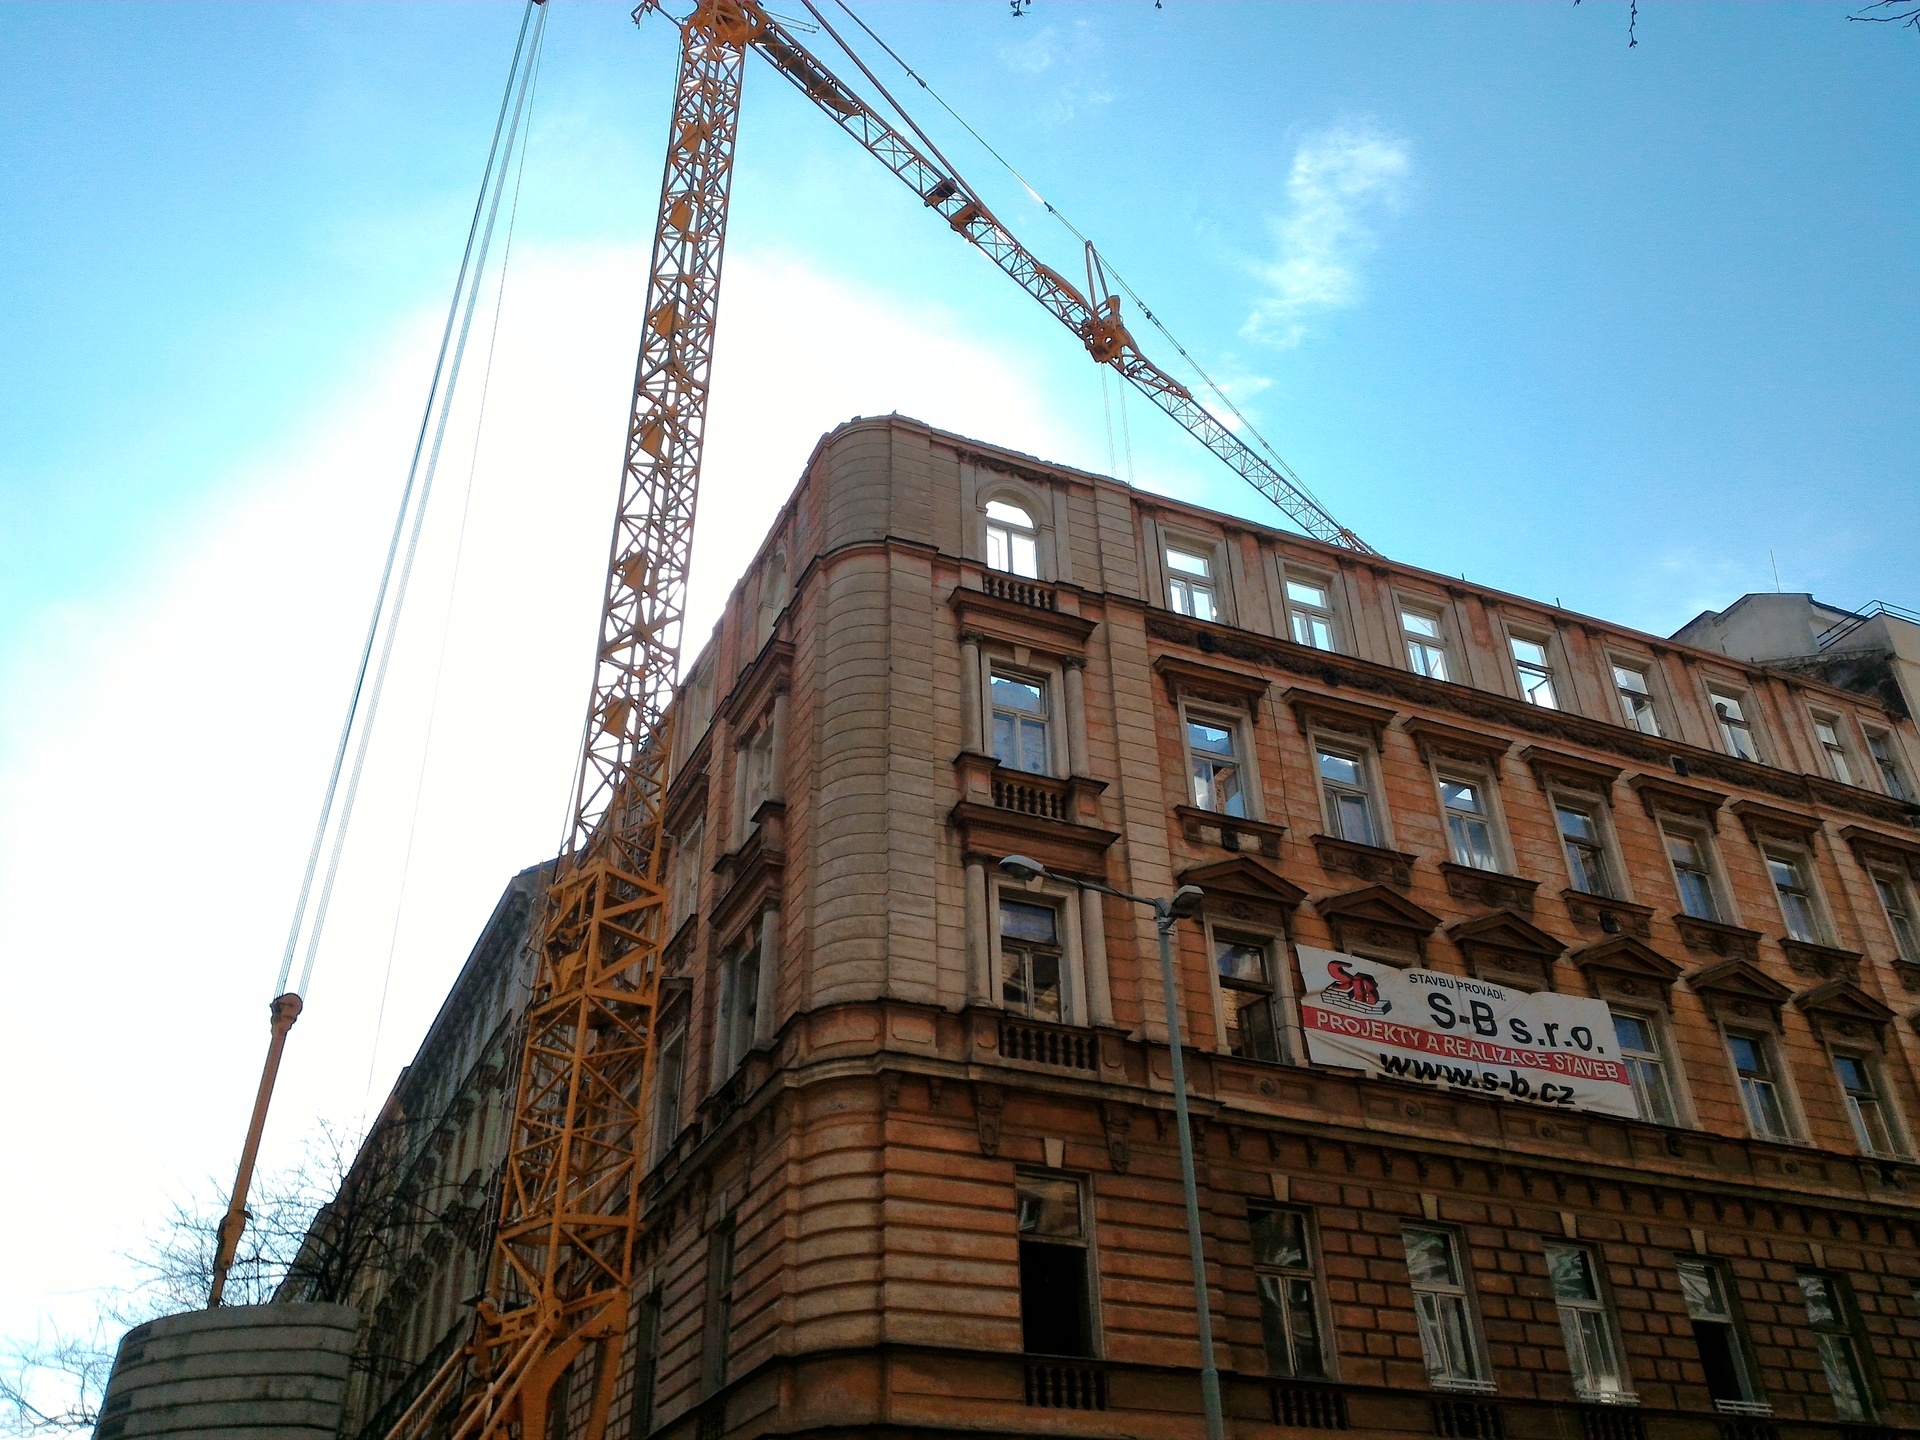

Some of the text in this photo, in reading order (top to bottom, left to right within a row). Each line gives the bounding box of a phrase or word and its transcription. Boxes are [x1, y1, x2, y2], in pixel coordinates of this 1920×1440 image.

[1409, 973, 1507, 1002] STAVBU PROVÁDÍ:
[1317, 1011, 1619, 1079] PROJEKTY A REALIZACE STAVEB
[1427, 992, 1604, 1054] S-B s.r.o.
[1380, 1054, 1575, 1104] www.s-b.cz
